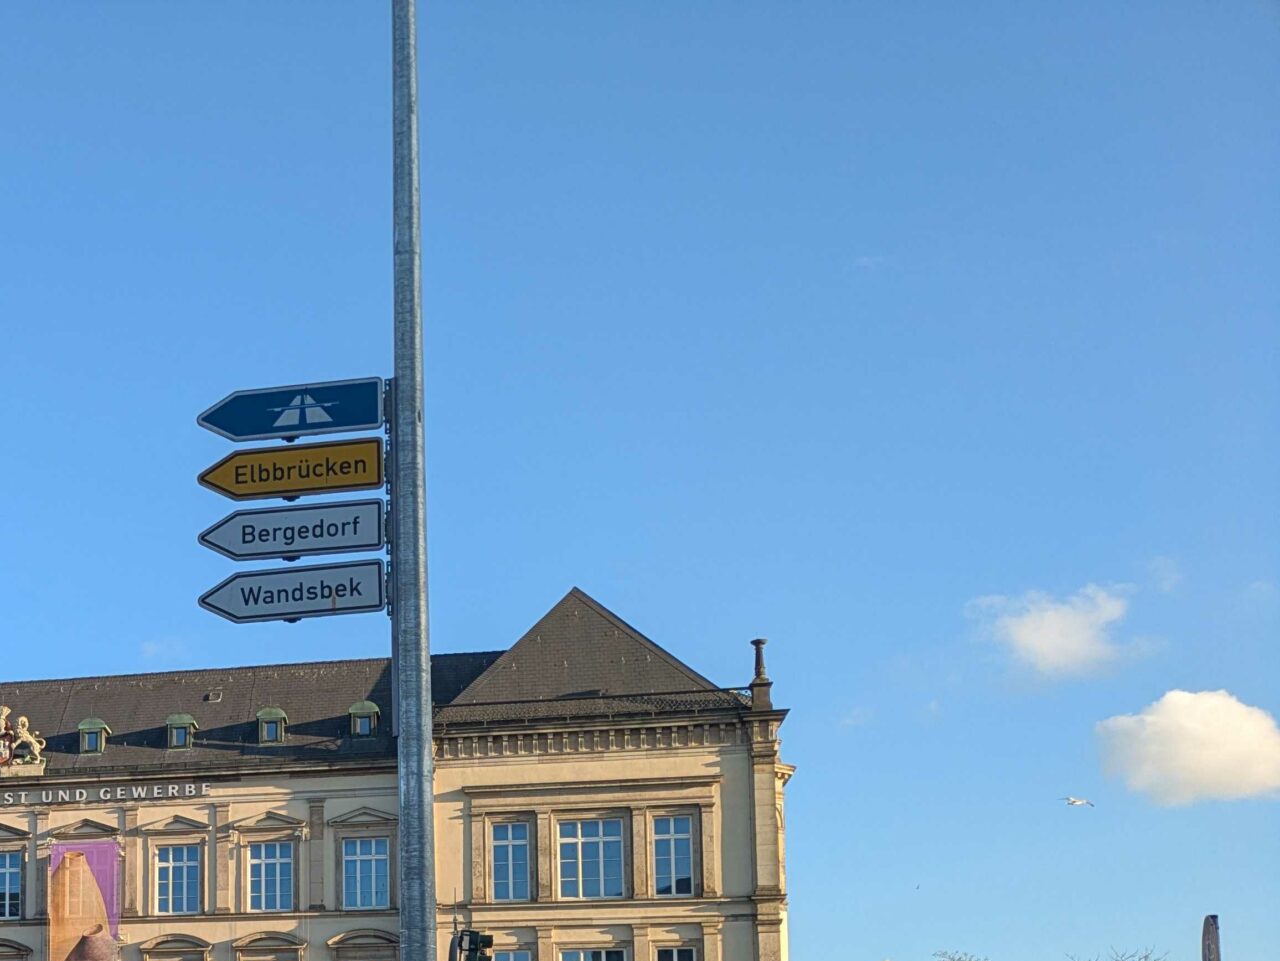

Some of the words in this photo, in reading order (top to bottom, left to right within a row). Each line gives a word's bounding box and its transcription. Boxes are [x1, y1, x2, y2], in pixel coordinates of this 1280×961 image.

[234, 457, 367, 485] Elbbrücken
[241, 516, 360, 546] Bergedorf
[240, 577, 363, 607] Wandsbek
[42, 789, 88, 803] UND
[99, 783, 211, 800] GEWERBE
